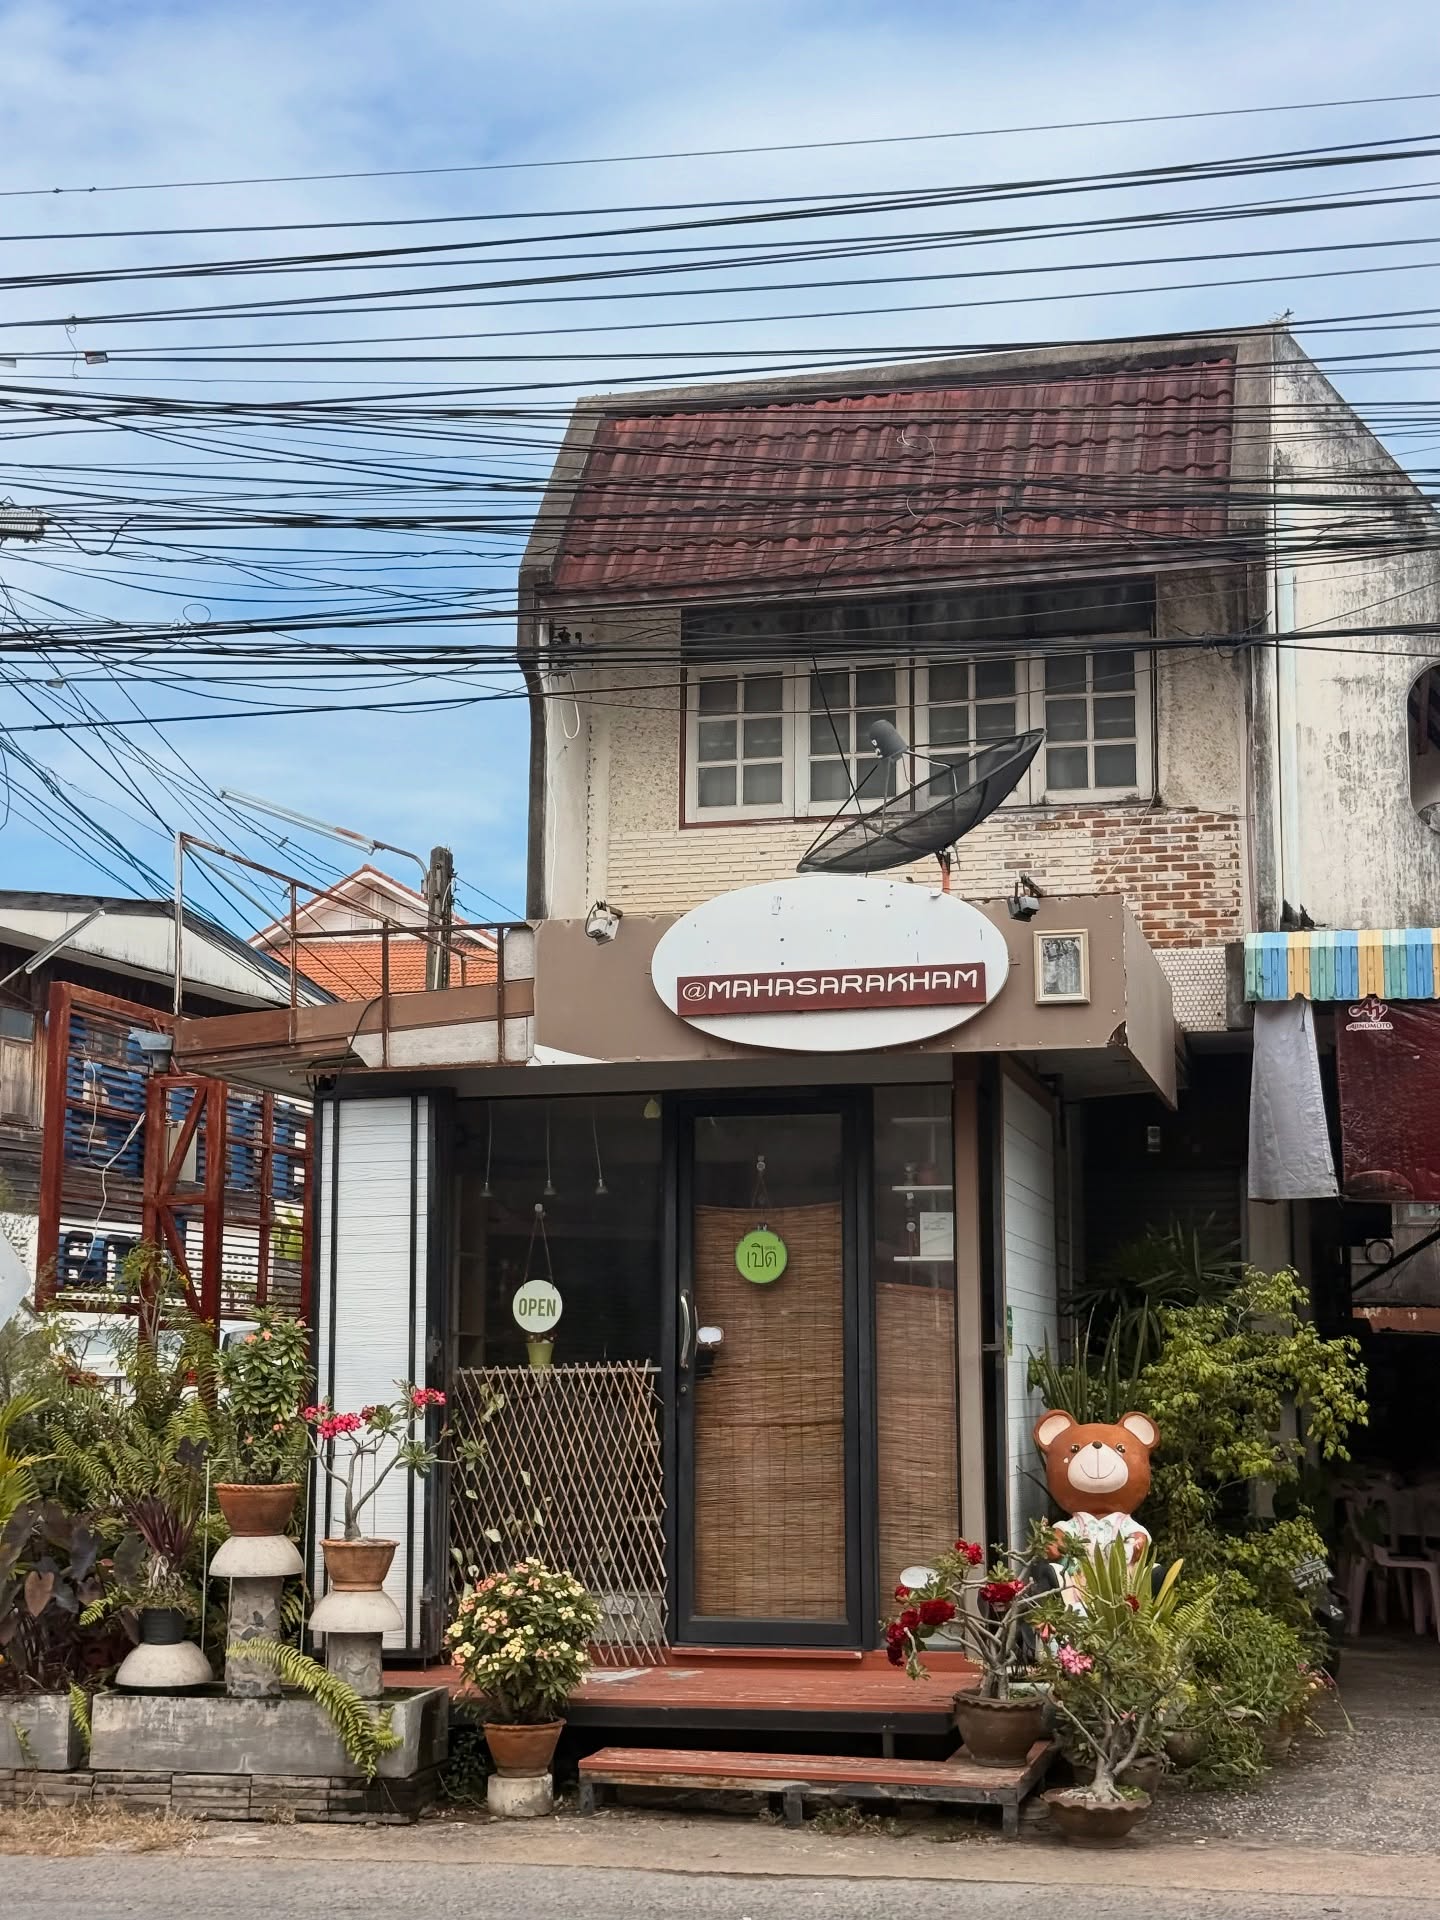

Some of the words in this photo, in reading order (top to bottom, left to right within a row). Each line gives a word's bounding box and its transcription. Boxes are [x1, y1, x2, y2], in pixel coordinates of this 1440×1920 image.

[682, 969, 978, 1001] @MAHASARAKHAM
[747, 1243, 777, 1268] เปิด
[518, 1298, 556, 1317] OPEN
